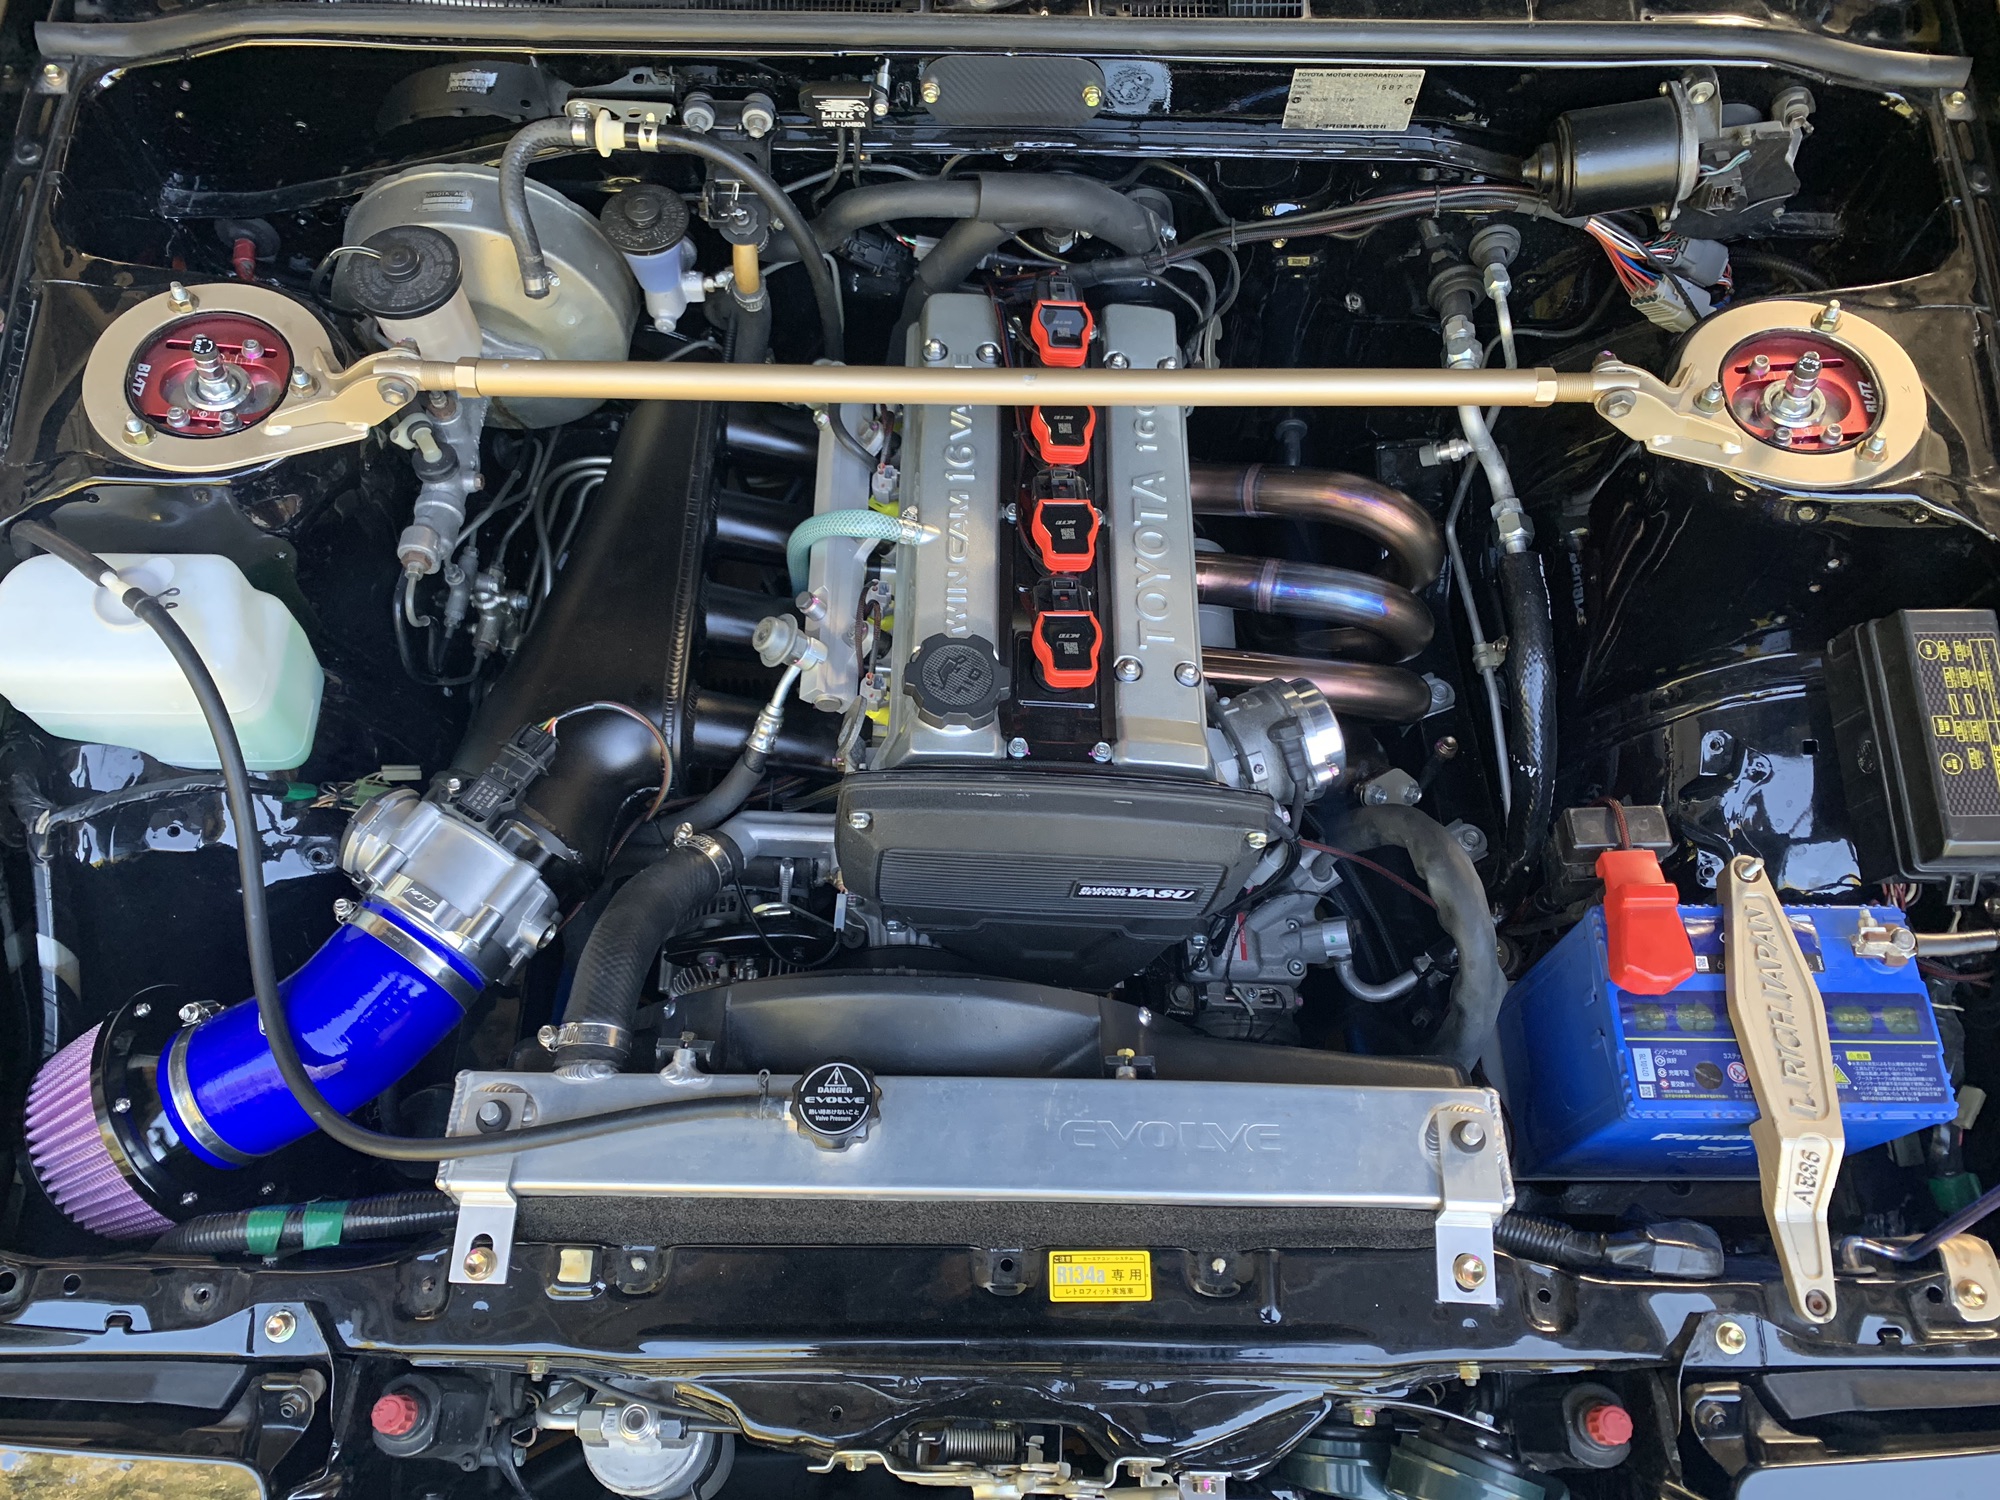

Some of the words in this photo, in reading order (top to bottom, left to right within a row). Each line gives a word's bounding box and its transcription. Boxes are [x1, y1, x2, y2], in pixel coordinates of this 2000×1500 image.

[945, 490, 970, 563] CAM
[1132, 471, 1176, 650] TOYOTA
[1127, 887, 1195, 900] YASU
[1744, 905, 1794, 1000] JAPAN
[804, 1096, 865, 1104] EVOLVE
[817, 1086, 853, 1094] DANGER
[1058, 1119, 1282, 1152] EVOLVE
[1056, 1265, 1106, 1285] R134a
[1111, 1268, 1142, 1282] 専用
[1065, 1287, 1134, 1295] レトロフィット実施車
